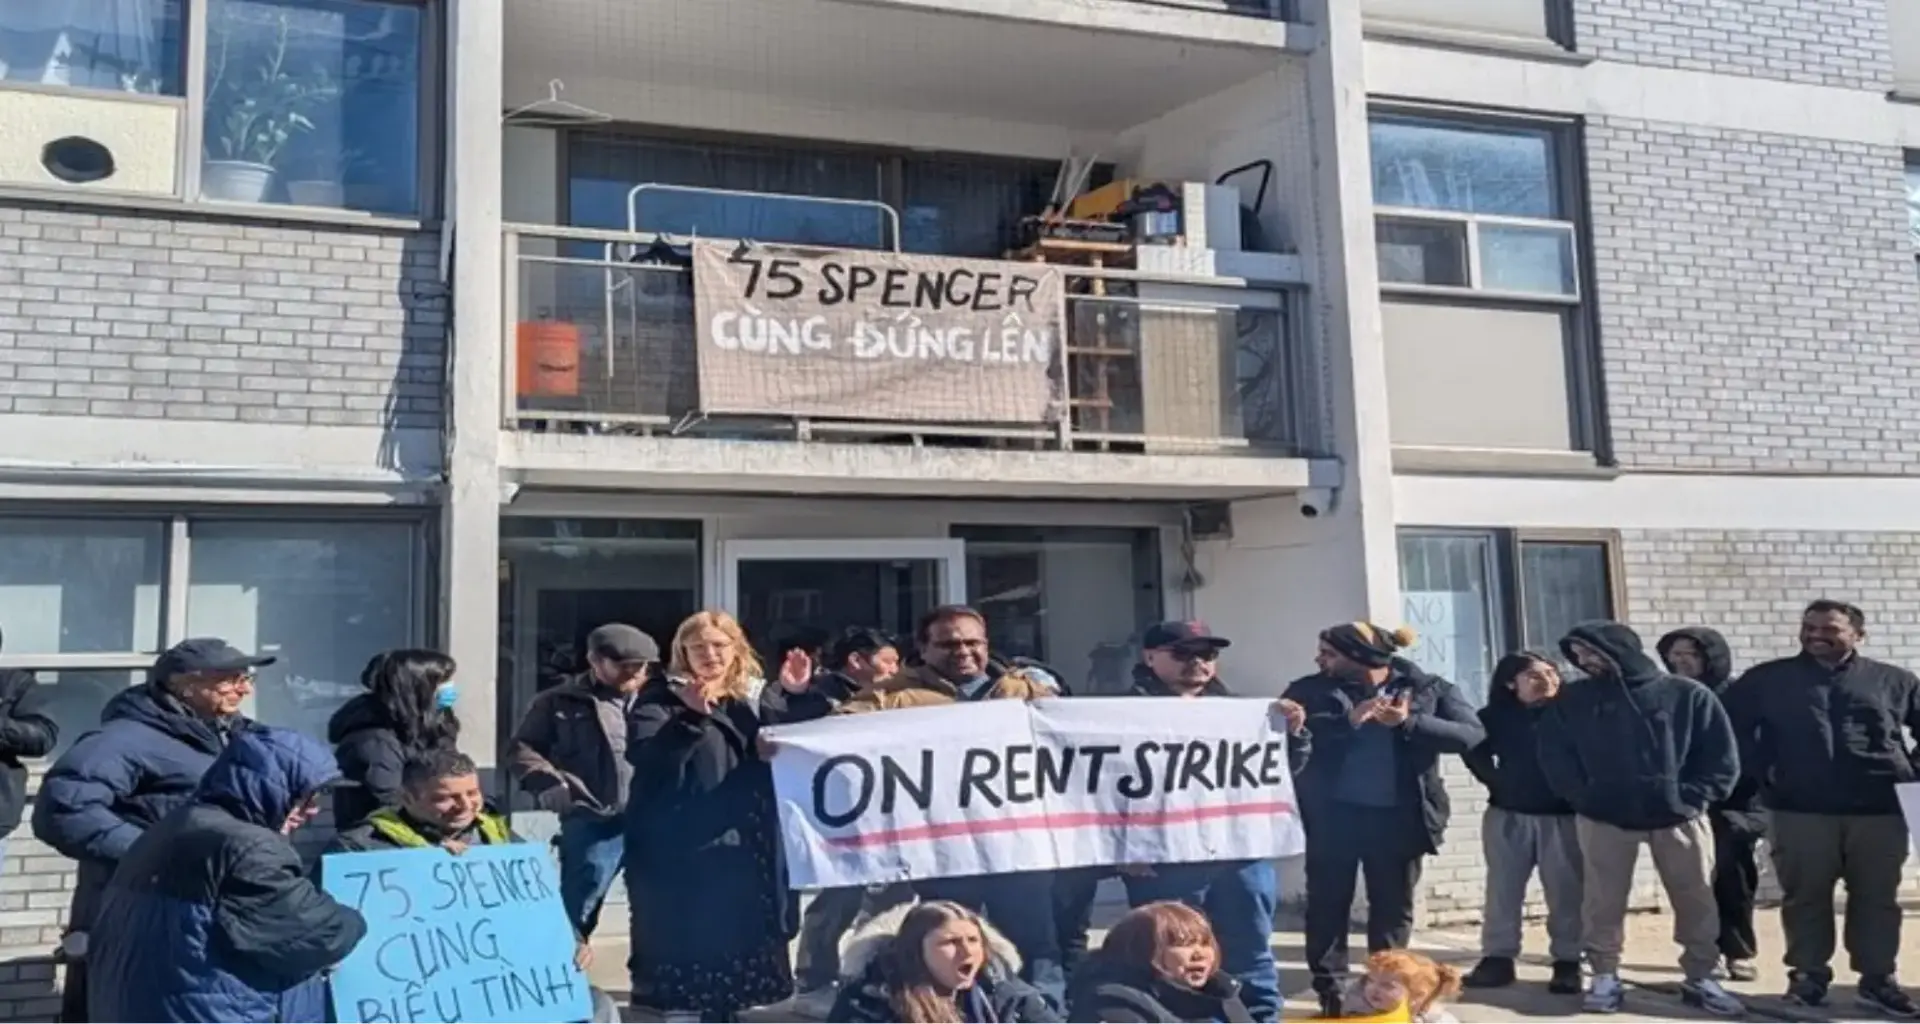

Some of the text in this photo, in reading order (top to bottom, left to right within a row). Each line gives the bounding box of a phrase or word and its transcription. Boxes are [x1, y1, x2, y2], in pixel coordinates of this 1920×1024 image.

[727, 248, 1038, 313] 75 SPENCER
[711, 303, 832, 355] CÙNG
[982, 311, 1050, 362] LÊN
[1404, 596, 1445, 624] NO
[812, 740, 1281, 828] ON RENT STRIKE
[344, 856, 554, 918] 75 SPENCER
[375, 917, 501, 985] CÙNG
[471, 955, 575, 1017] TÌNH
